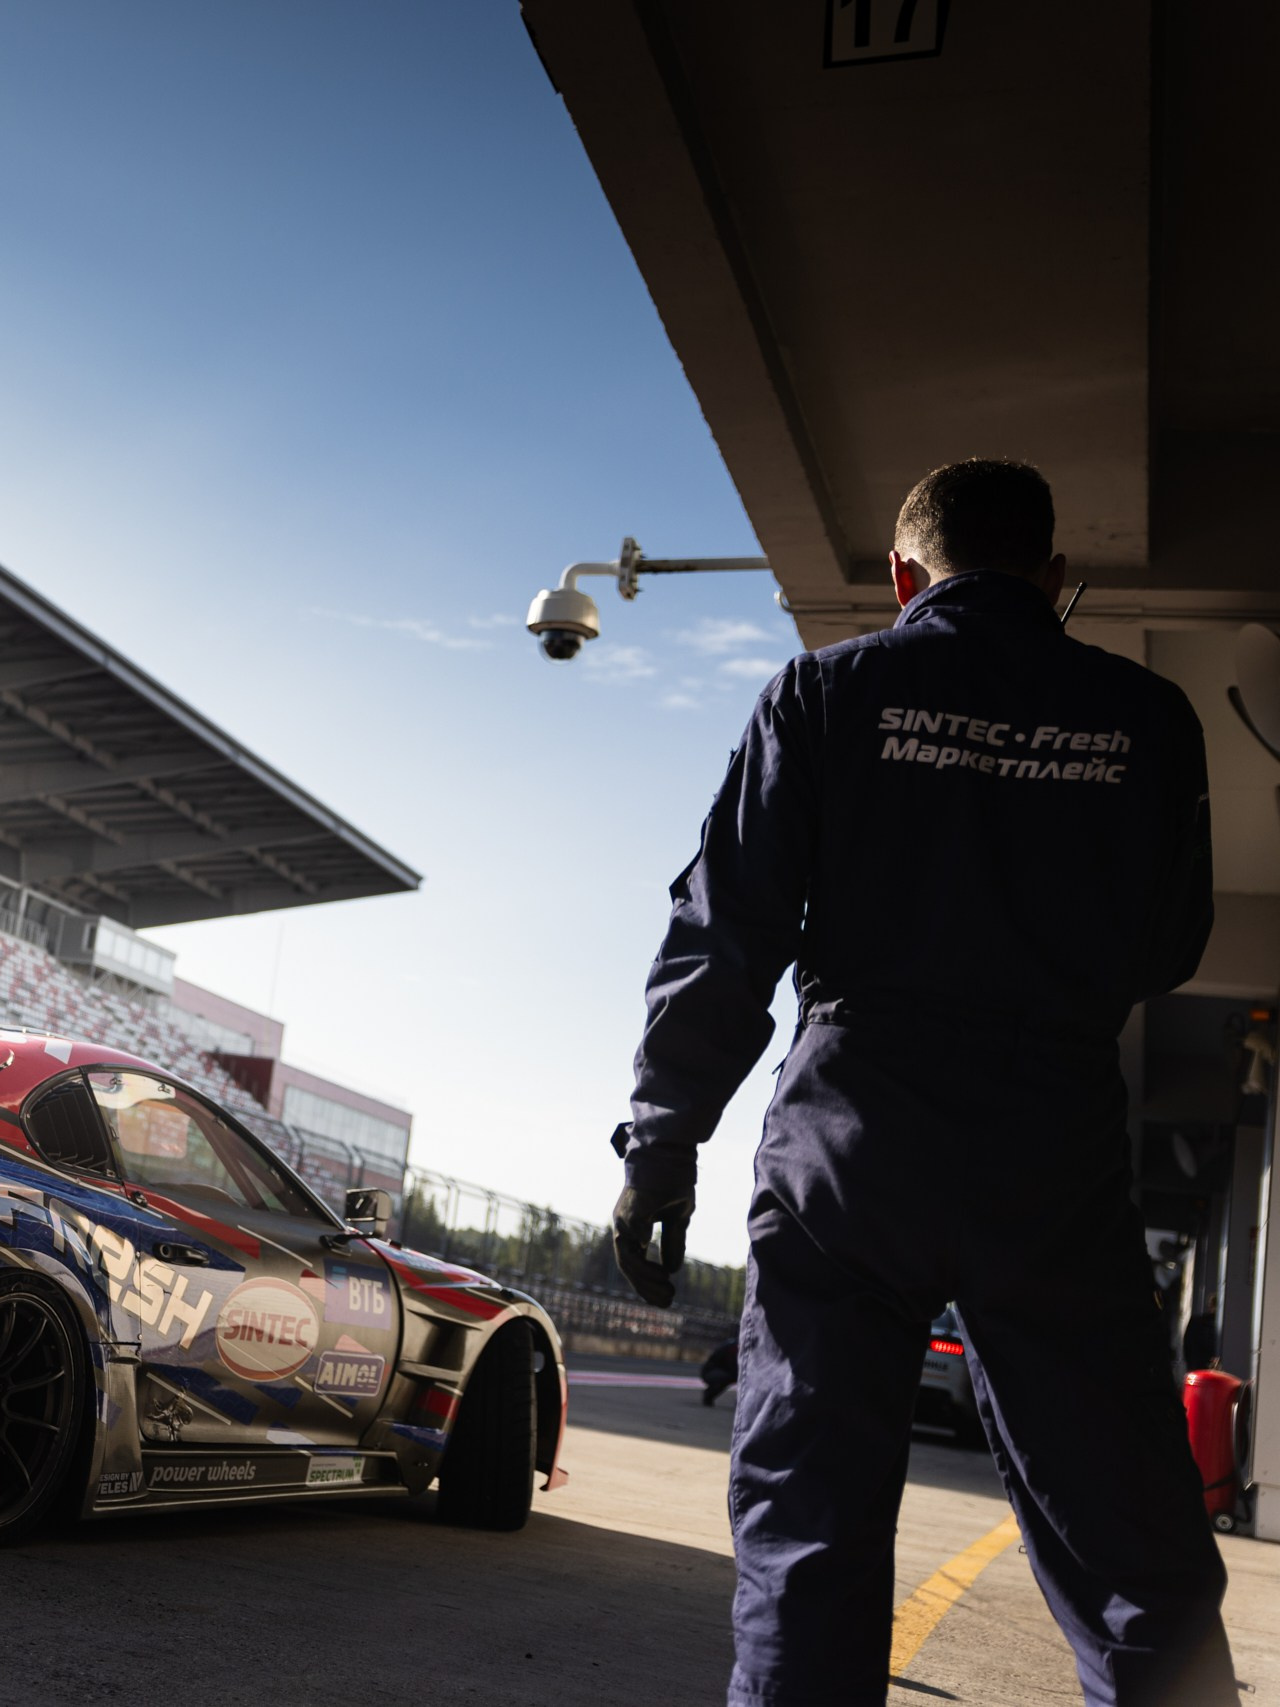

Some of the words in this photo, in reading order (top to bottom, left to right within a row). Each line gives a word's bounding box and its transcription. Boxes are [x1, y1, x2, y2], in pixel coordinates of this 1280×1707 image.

[878, 707, 1010, 746] SINTEC
[1030, 726, 1131, 753] Fresh
[880, 736, 1127, 784] Маркетплейс
[222, 1308, 312, 1348] SINTEC
[318, 1361, 379, 1388] AIMOL
[99, 1472, 120, 1482] ESIGN
[149, 1462, 206, 1486] power
[207, 1460, 257, 1481] wheels
[309, 1469, 354, 1482] SPECTRUM
